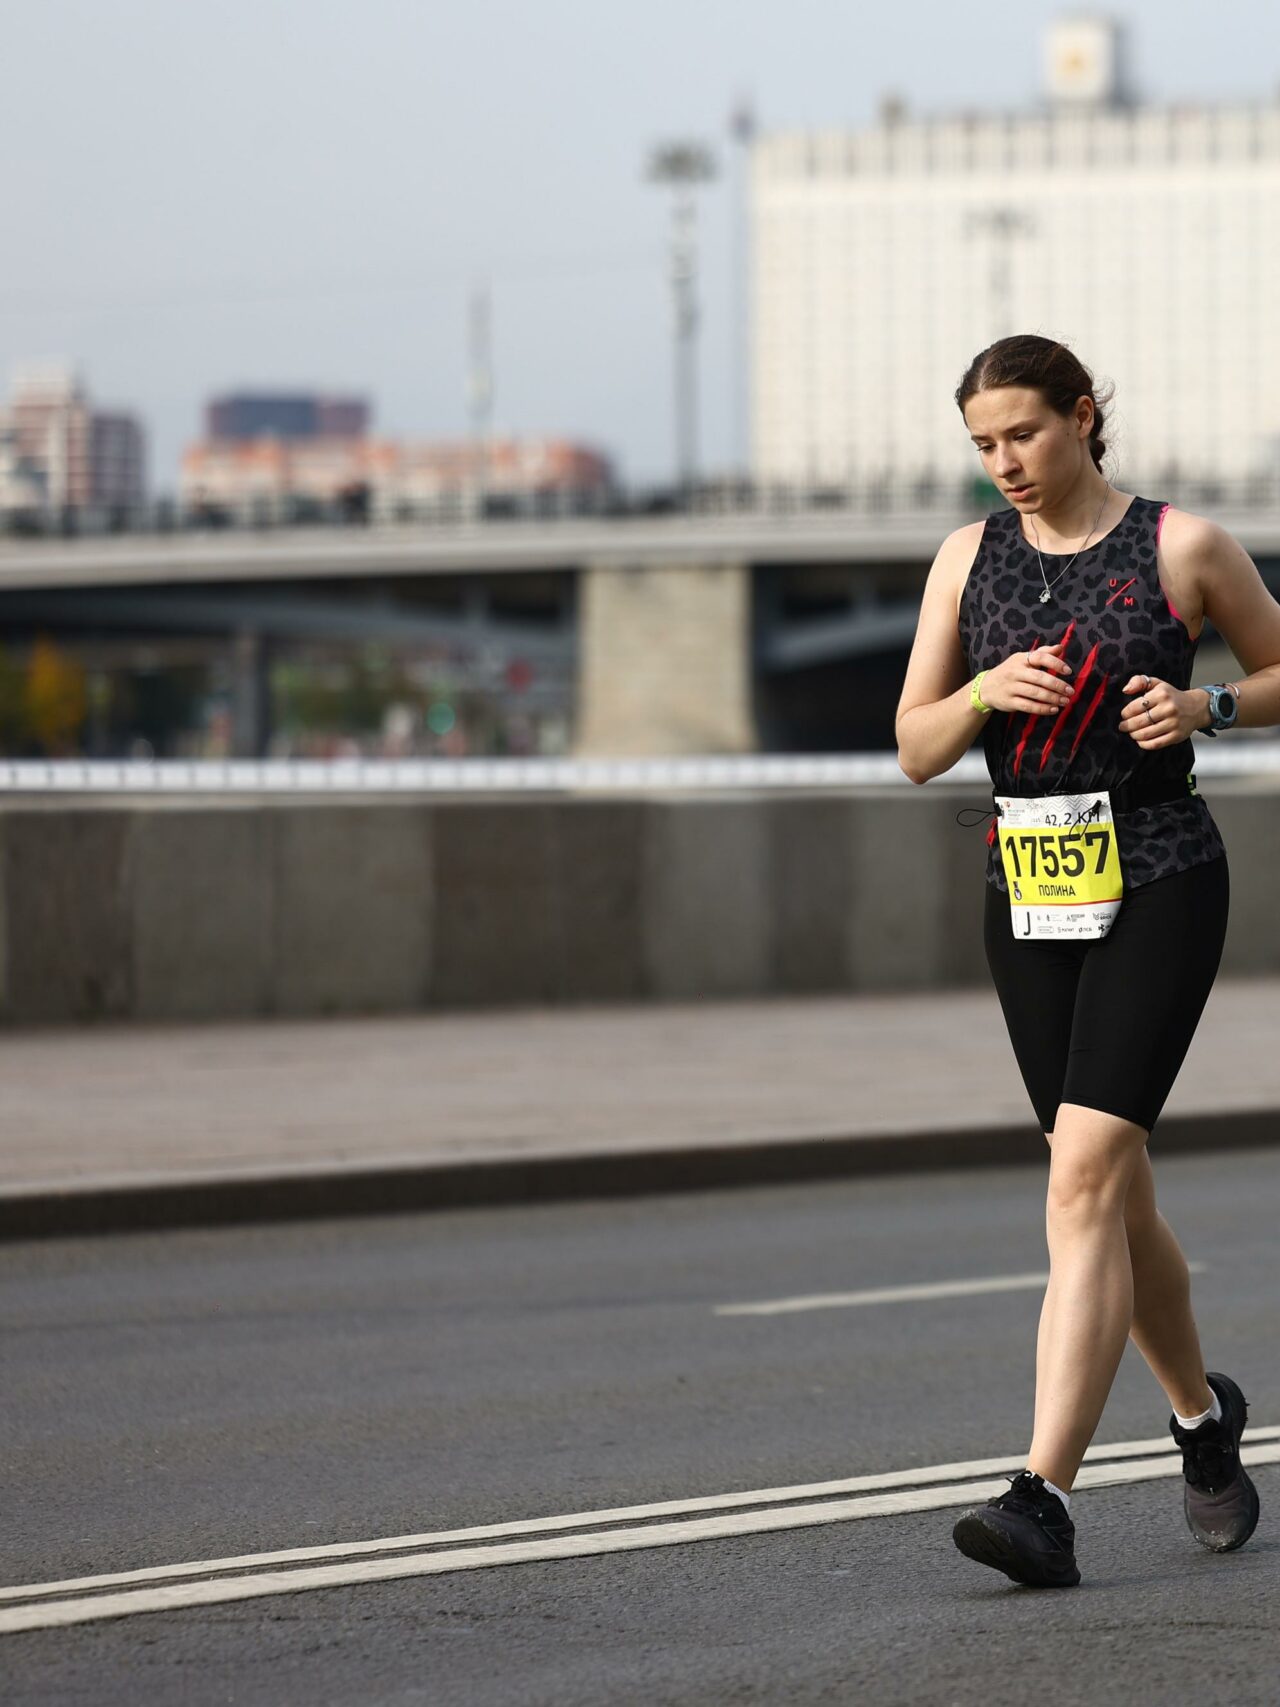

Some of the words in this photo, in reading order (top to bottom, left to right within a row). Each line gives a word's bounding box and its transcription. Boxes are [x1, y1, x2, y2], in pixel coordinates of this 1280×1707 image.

[1005, 830, 1110, 878] 17557
[1038, 884, 1076, 897] ПОЛИНА
[1023, 911, 1032, 936] J
